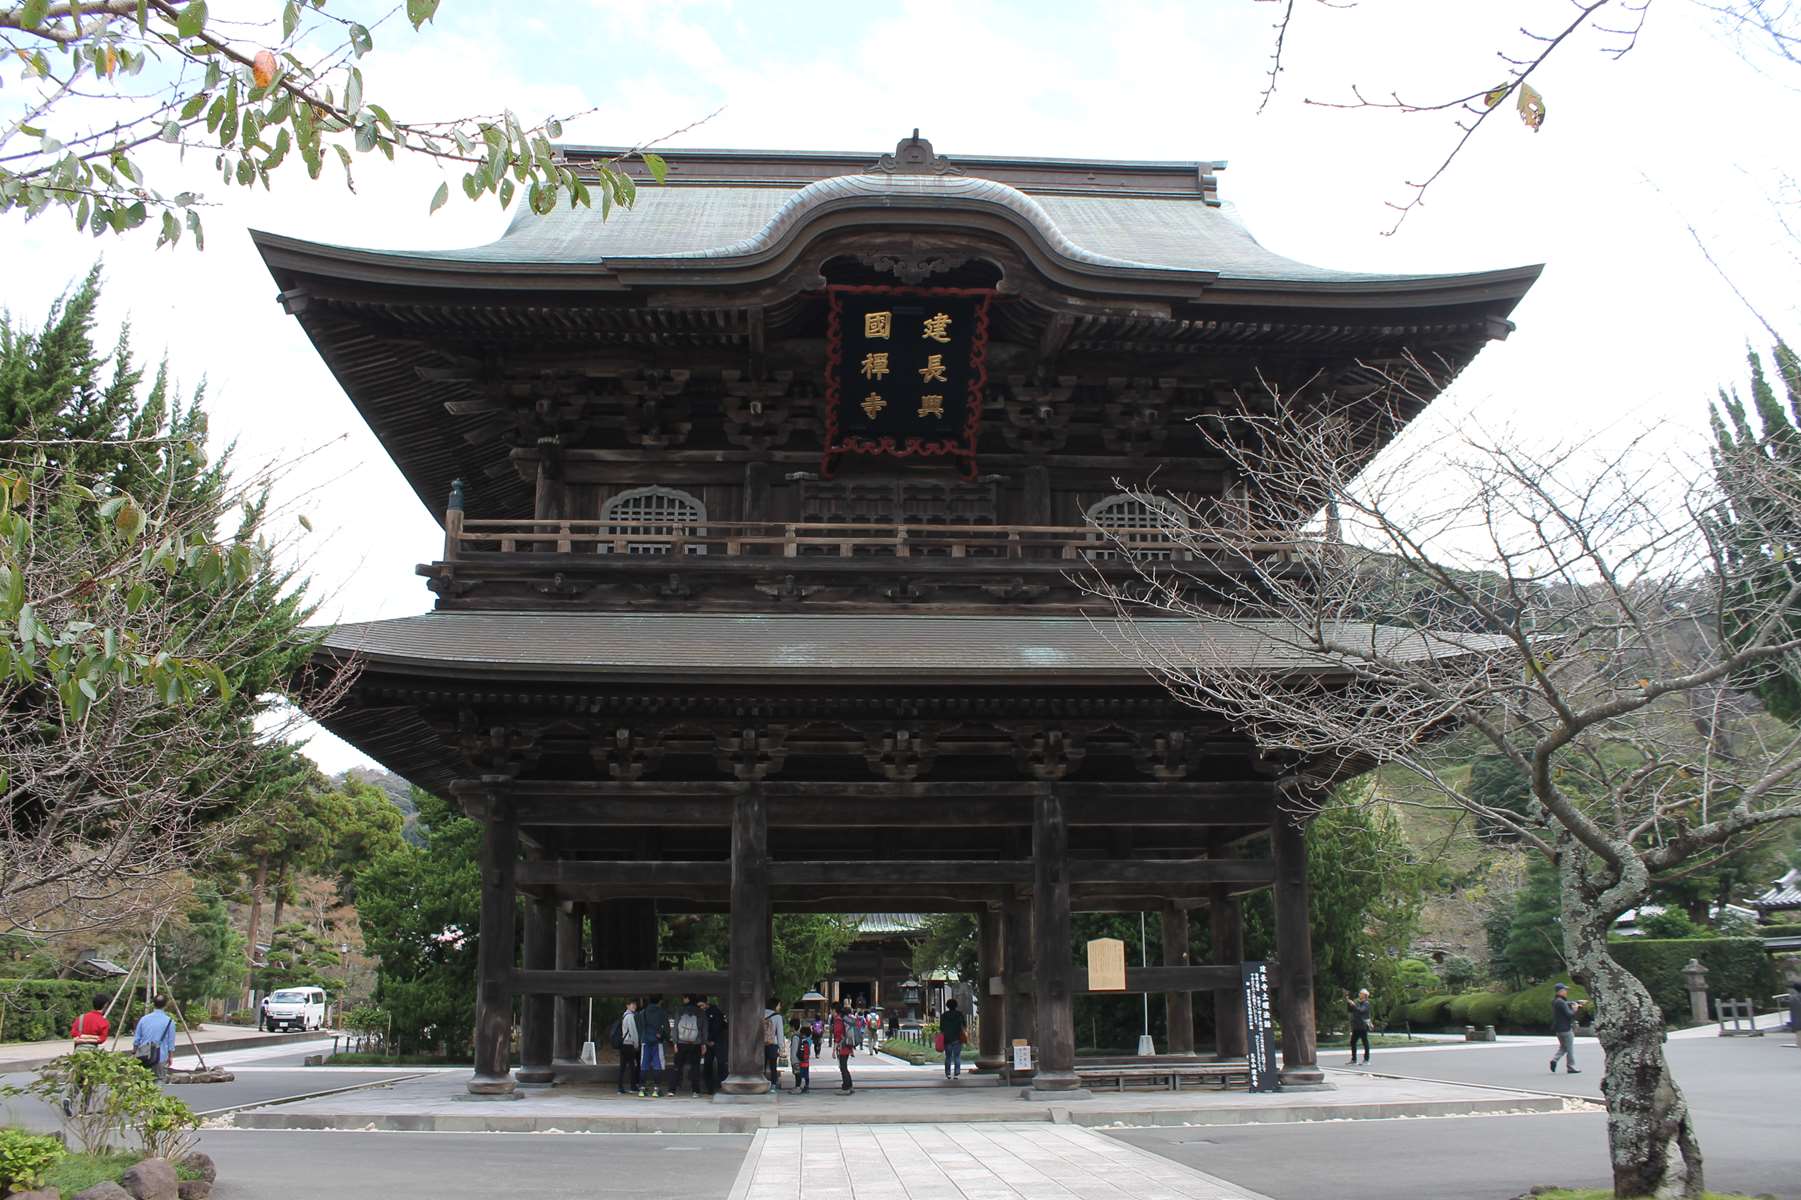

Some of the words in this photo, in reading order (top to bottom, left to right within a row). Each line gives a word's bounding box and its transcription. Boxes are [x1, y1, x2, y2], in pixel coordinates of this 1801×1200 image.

[861, 311, 892, 420] 國禪寺
[917, 312, 952, 419] 建長興
